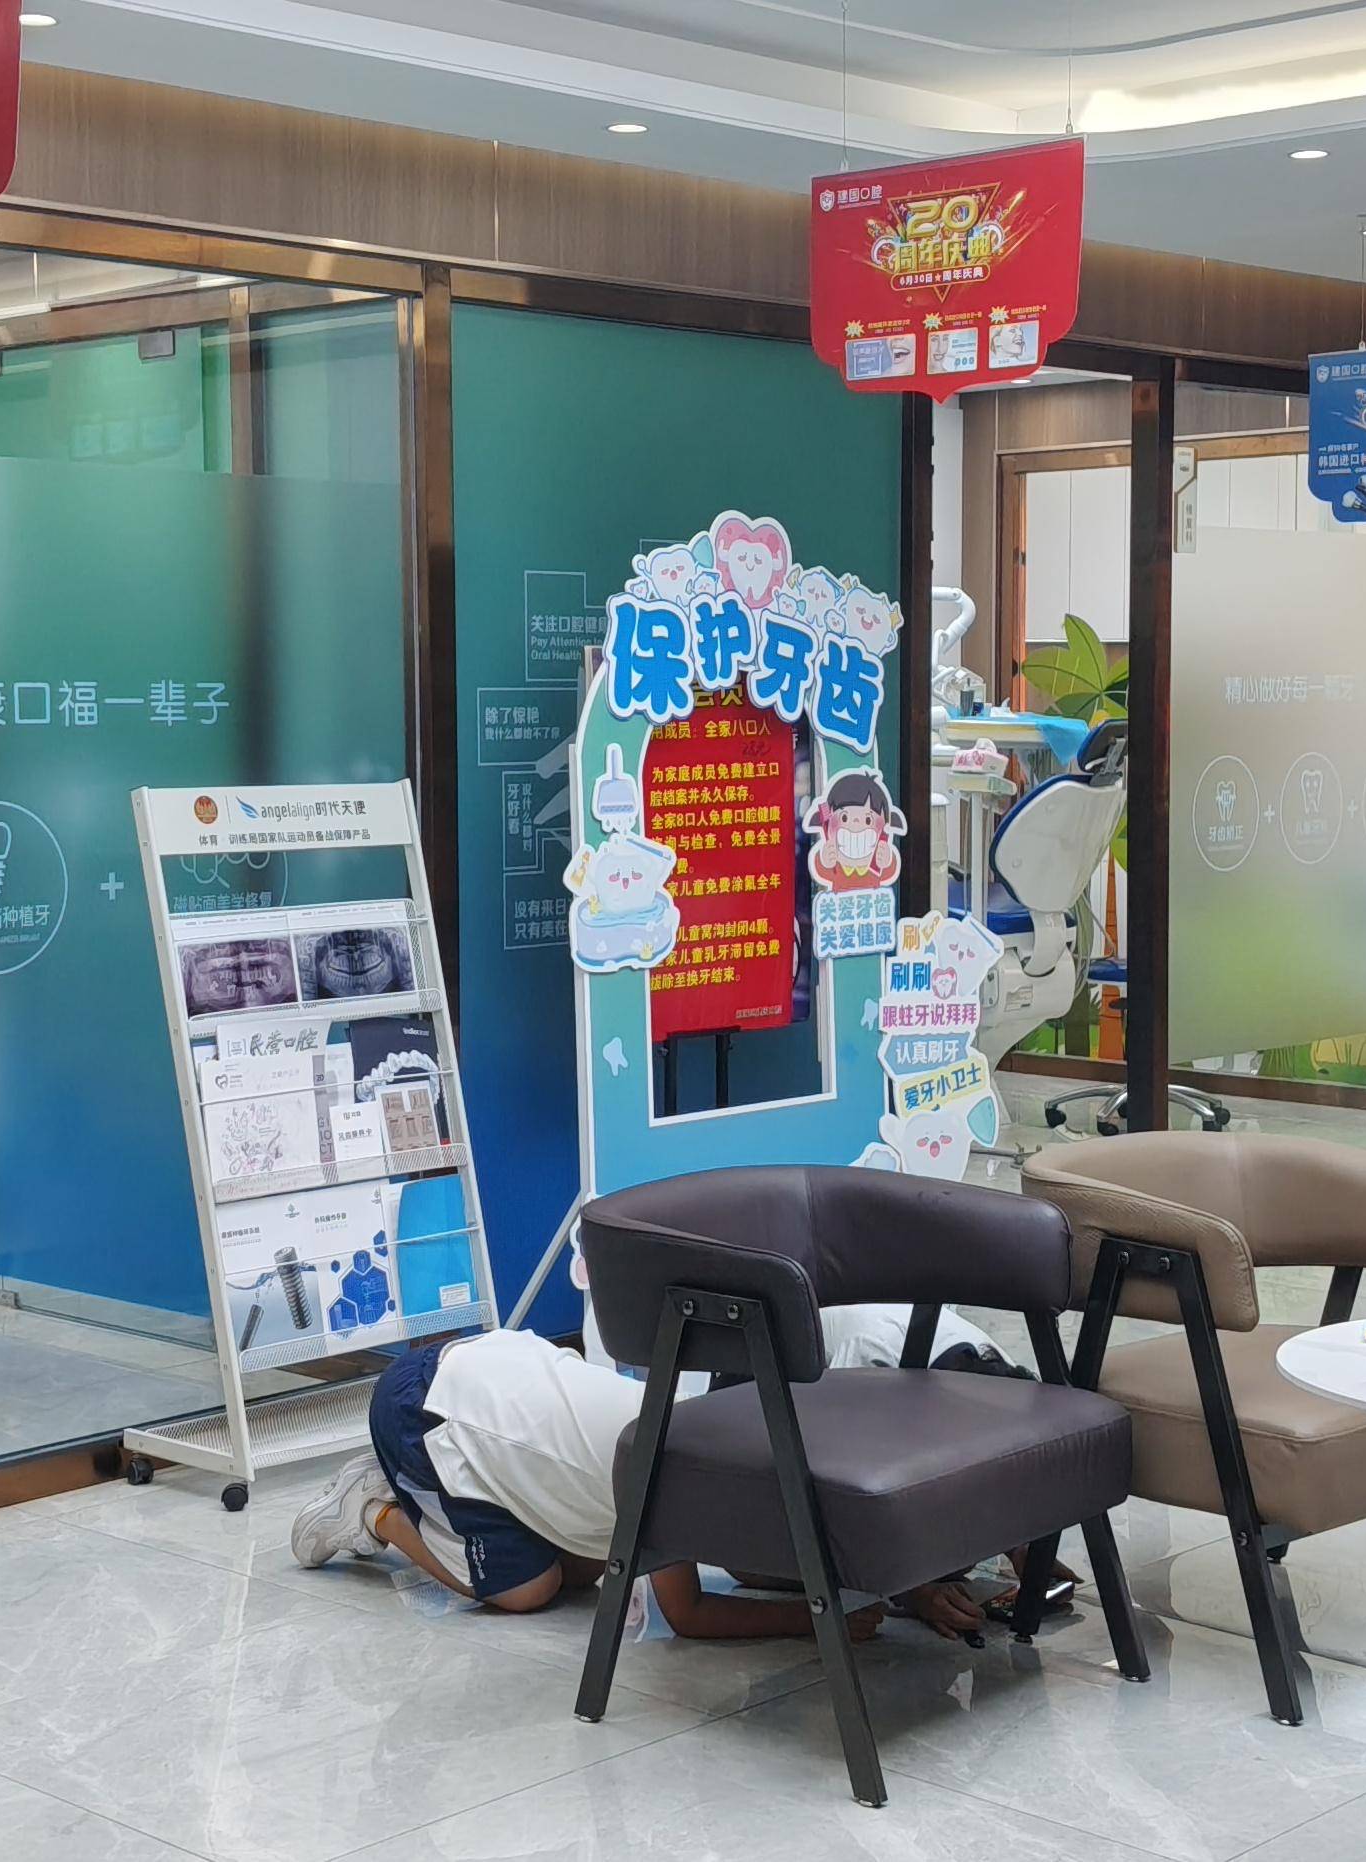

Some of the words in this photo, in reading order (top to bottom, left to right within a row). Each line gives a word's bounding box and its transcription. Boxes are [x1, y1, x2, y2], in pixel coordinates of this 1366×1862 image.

[905, 194, 979, 238] 20
[893, 234, 992, 273] 周年庆典
[531, 649, 550, 660] Oral
[555, 650, 582, 661] Health
[615, 597, 881, 747] 保护牙齿
[652, 761, 780, 783] 为家庭成员免费建立口
[650, 784, 755, 807] 腔档案并永久保存。
[651, 805, 781, 830] 全家8口人免费口腔健康
[667, 872, 781, 898] 家儿童免费涂氟全年
[819, 893, 892, 923] 关爱牙齿
[678, 918, 774, 942] 儿童窝沟封闭4颗。
[820, 924, 893, 952] 关爱健康
[653, 939, 781, 968] 家儿童乳牙滞留免费
[890, 962, 931, 993] 刷刷
[882, 1002, 977, 1029] 跟蛀牙说拜拜
[895, 1040, 960, 1067] 认真刷牙
[903, 1062, 983, 1111] 爱牙小卫士
